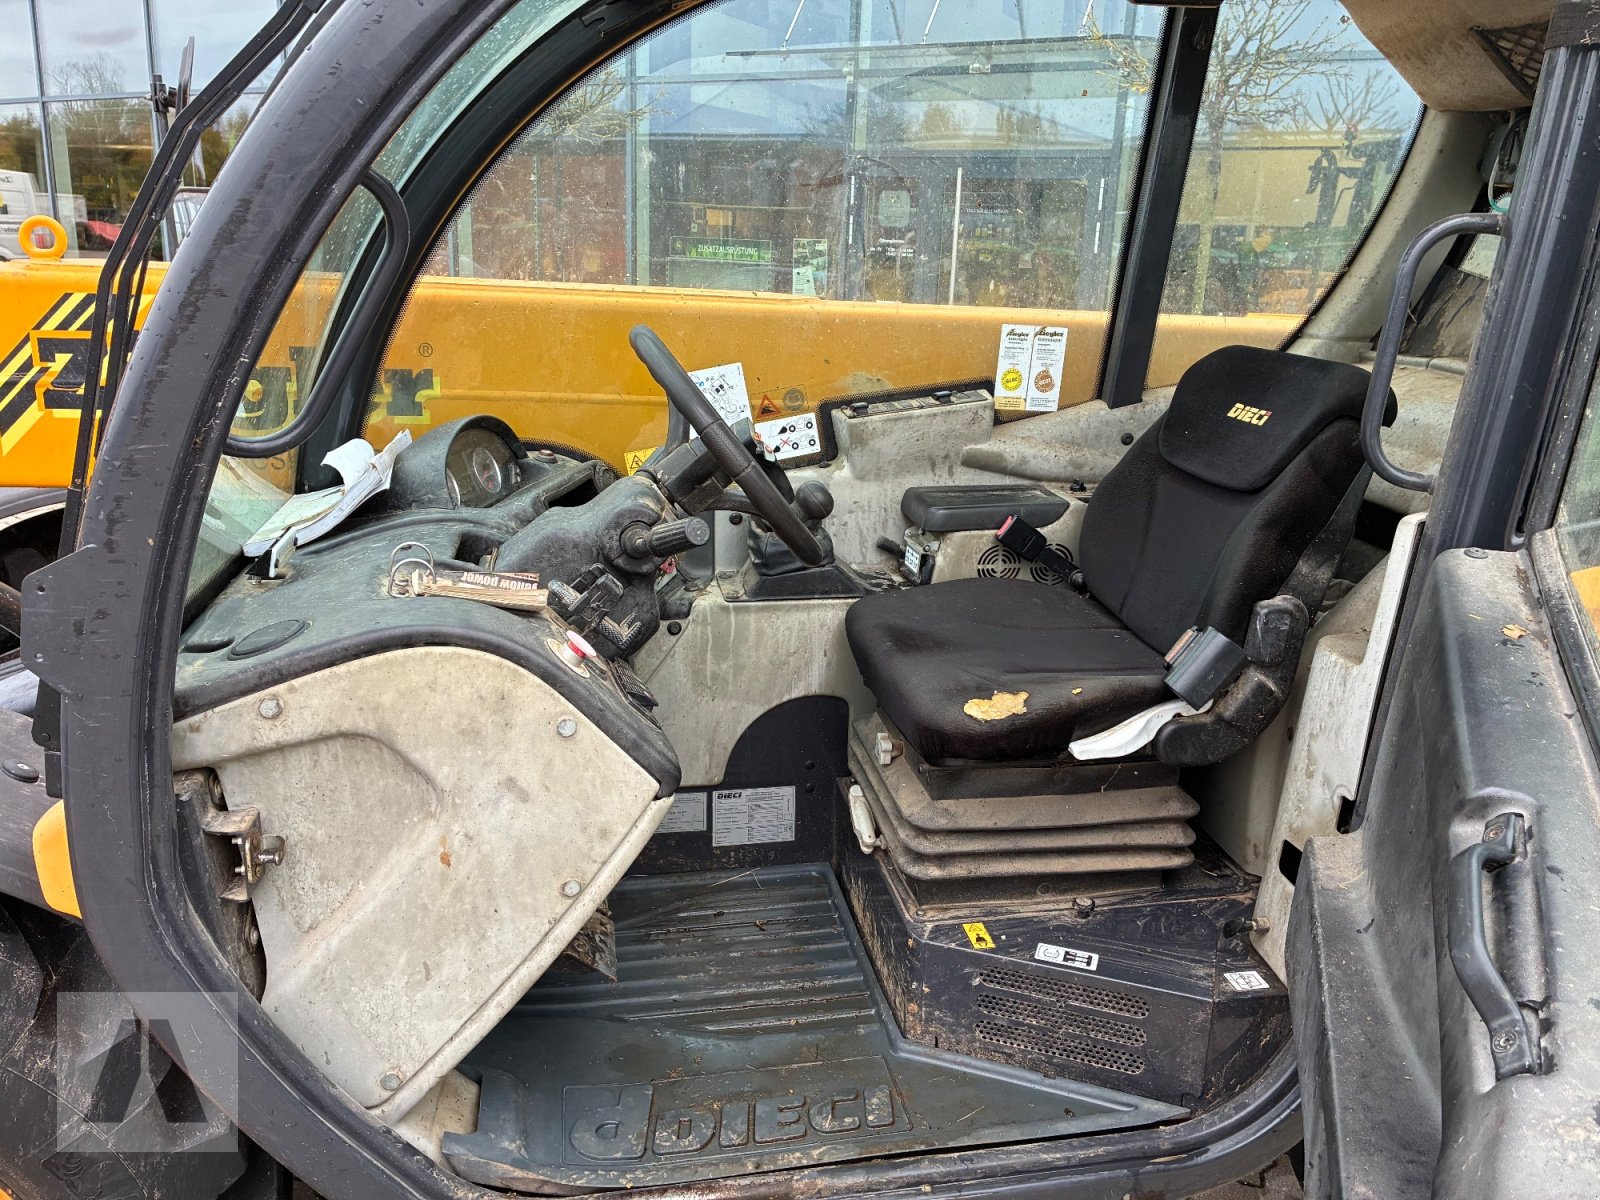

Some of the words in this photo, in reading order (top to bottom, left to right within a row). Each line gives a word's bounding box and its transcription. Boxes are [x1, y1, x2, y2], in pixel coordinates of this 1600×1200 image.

[697, 244, 758, 255] ZUSATZAUSRÜSTUNG
[1227, 402, 1272, 426] DIECI
[717, 792, 743, 800] DIECI
[652, 1084, 895, 1157] DIECI
